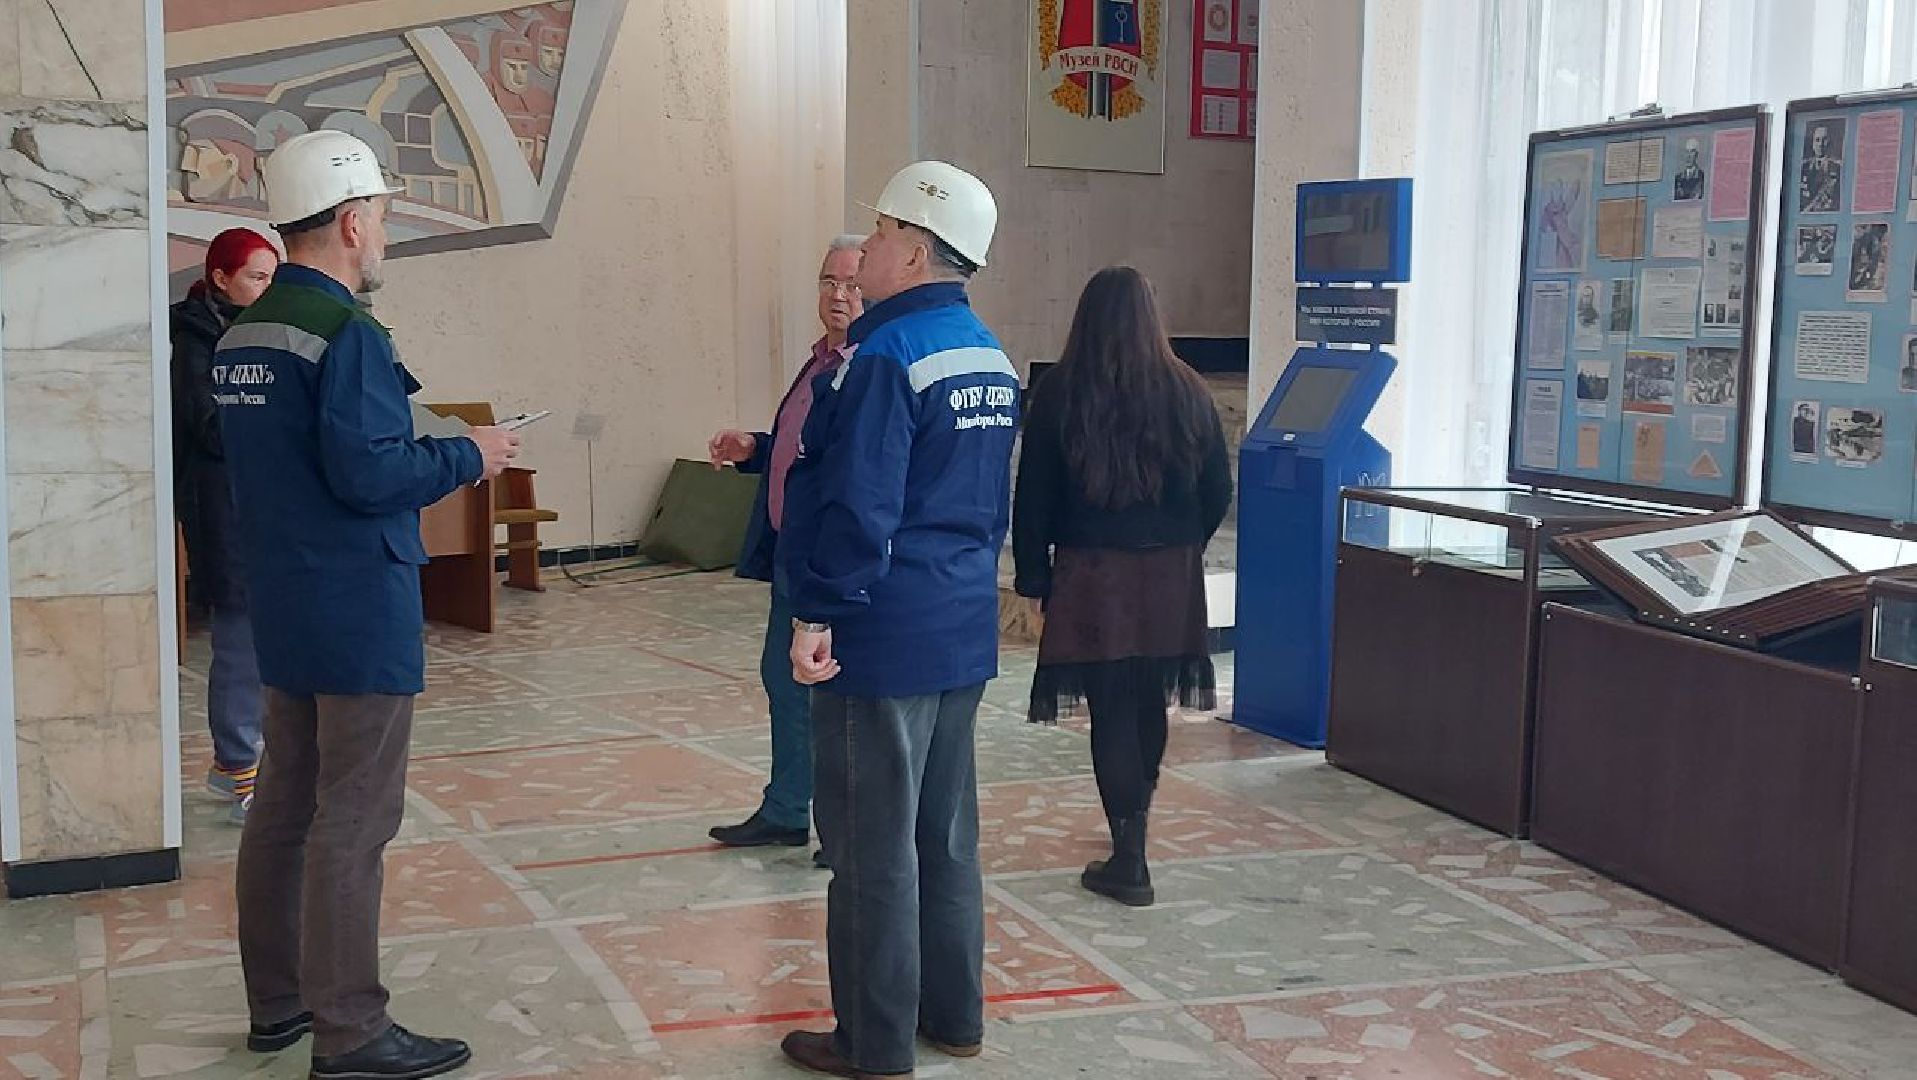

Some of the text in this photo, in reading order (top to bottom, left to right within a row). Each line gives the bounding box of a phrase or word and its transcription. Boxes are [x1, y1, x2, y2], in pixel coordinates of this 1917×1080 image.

[1059, 52, 1138, 77] Музей РВСН
[949, 386, 983, 410] ФГБУ
